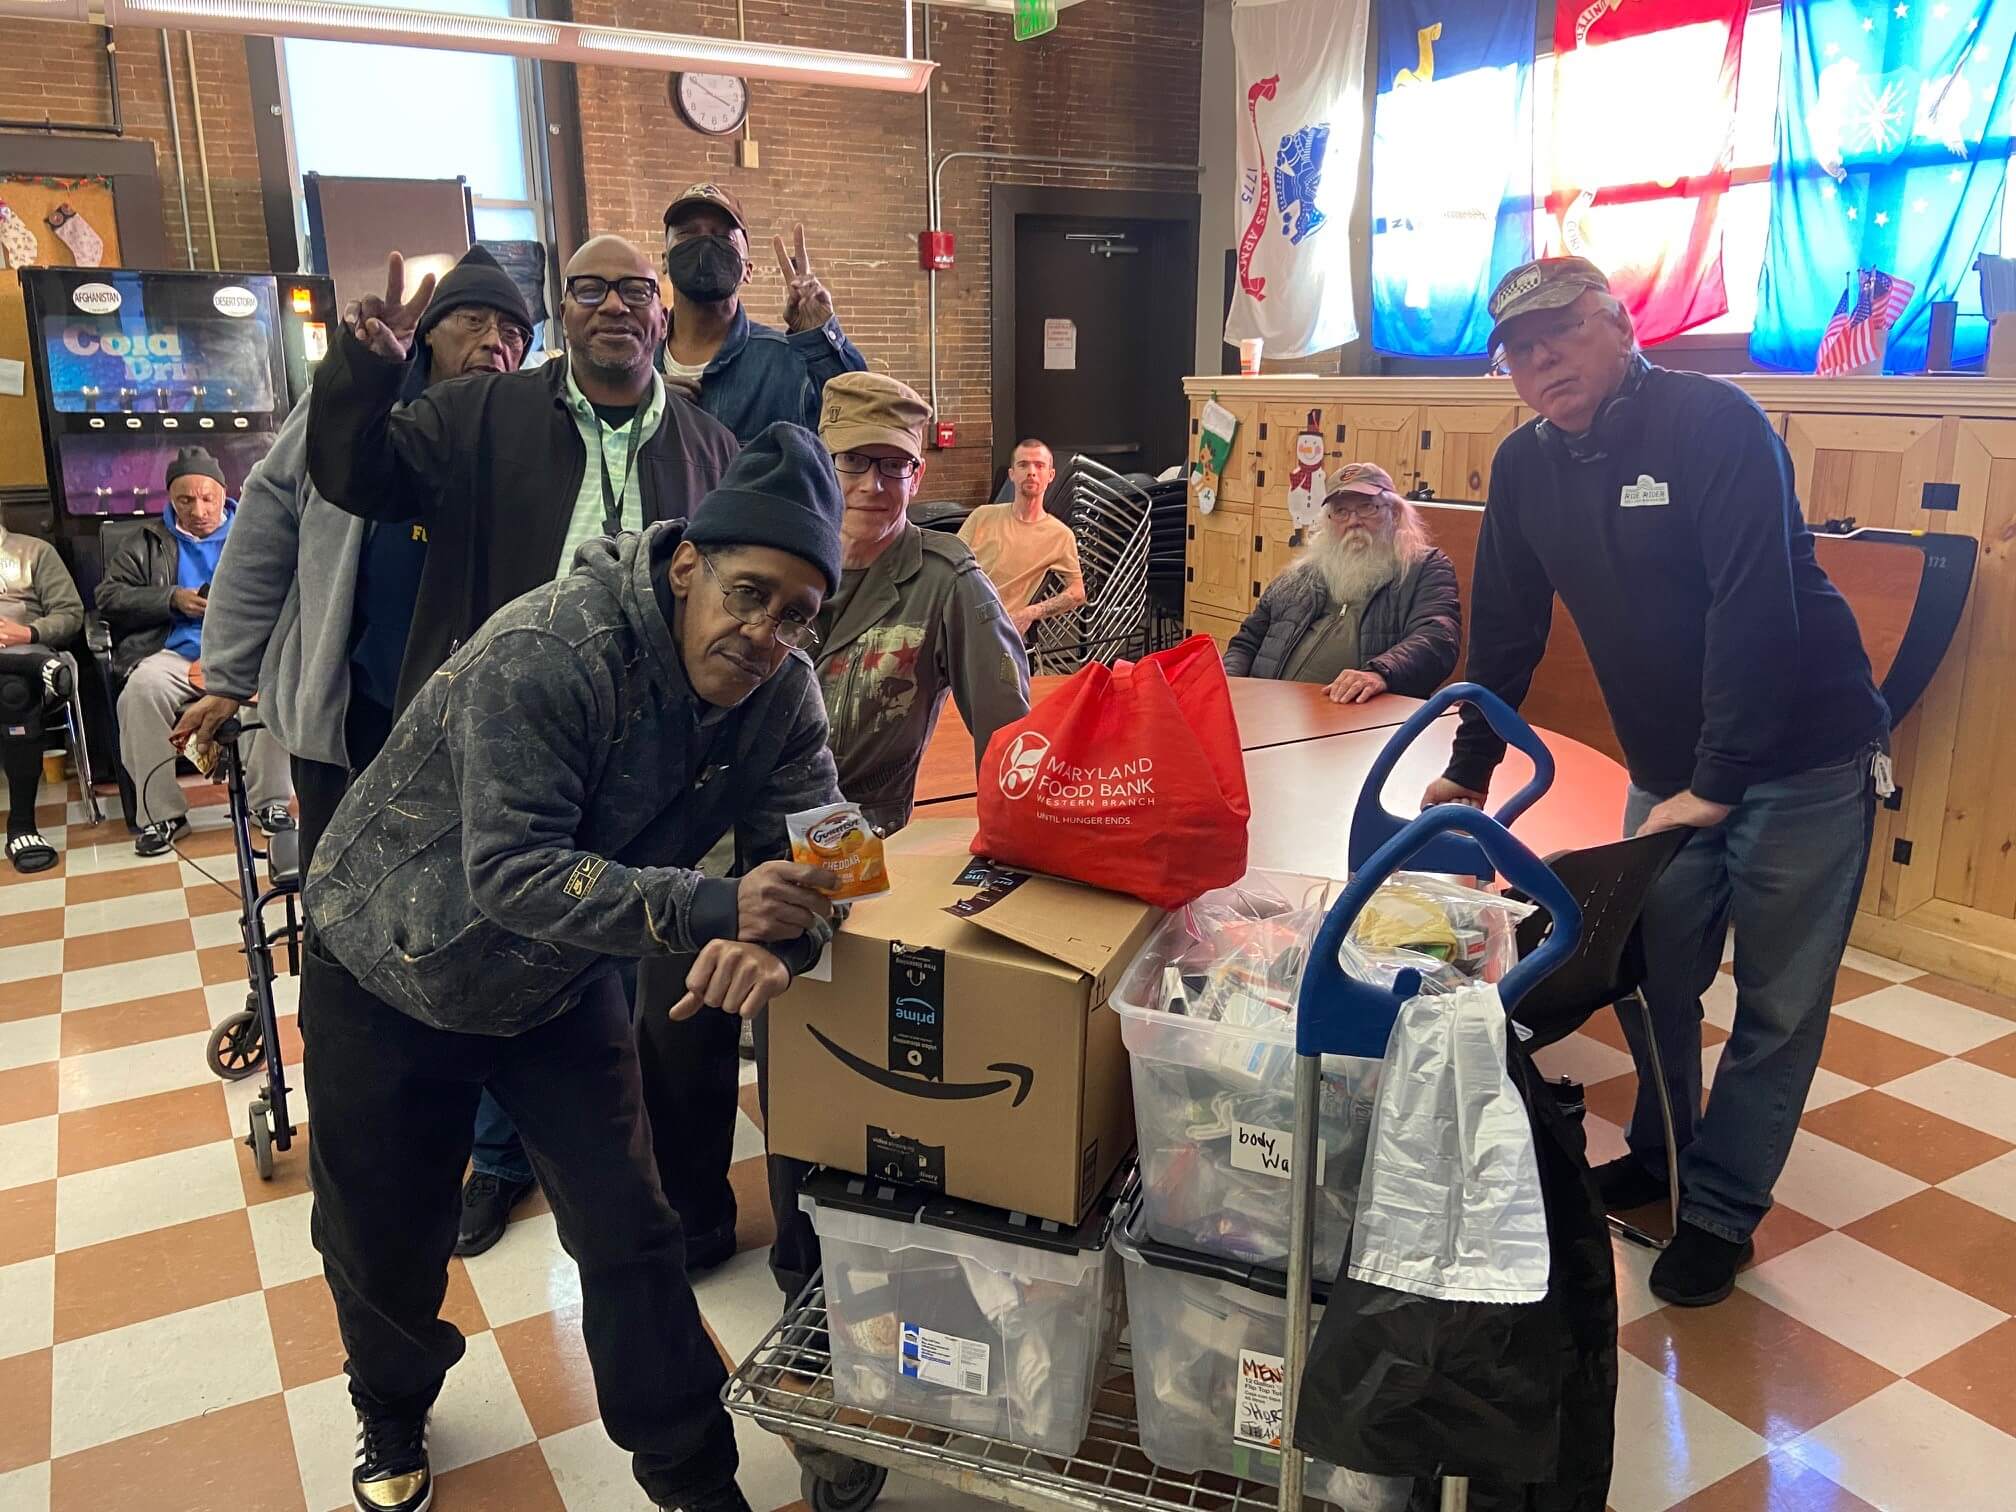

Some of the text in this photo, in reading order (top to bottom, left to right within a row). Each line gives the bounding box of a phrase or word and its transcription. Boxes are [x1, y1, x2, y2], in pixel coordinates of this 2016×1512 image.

[1241, 167, 1258, 205] 1775
[1240, 228, 1259, 280] ARMY
[74, 292, 120, 303] AFGHANISTAN
[63, 324, 182, 357] Cold
[1046, 755, 1154, 782] MARYLAND
[1038, 775, 1156, 799] FOOD BANK
[1036, 793, 1156, 808] WESTERN BRANCH
[1036, 811, 1134, 826] UNTIL HUNGER ENDS.
[822, 854, 861, 871] CHEDDAR
[895, 1008, 936, 1026] prime
[1239, 1126, 1277, 1156] body
[1262, 1152, 1290, 1173] Wa
[1242, 1357, 1284, 1383] MEN'
